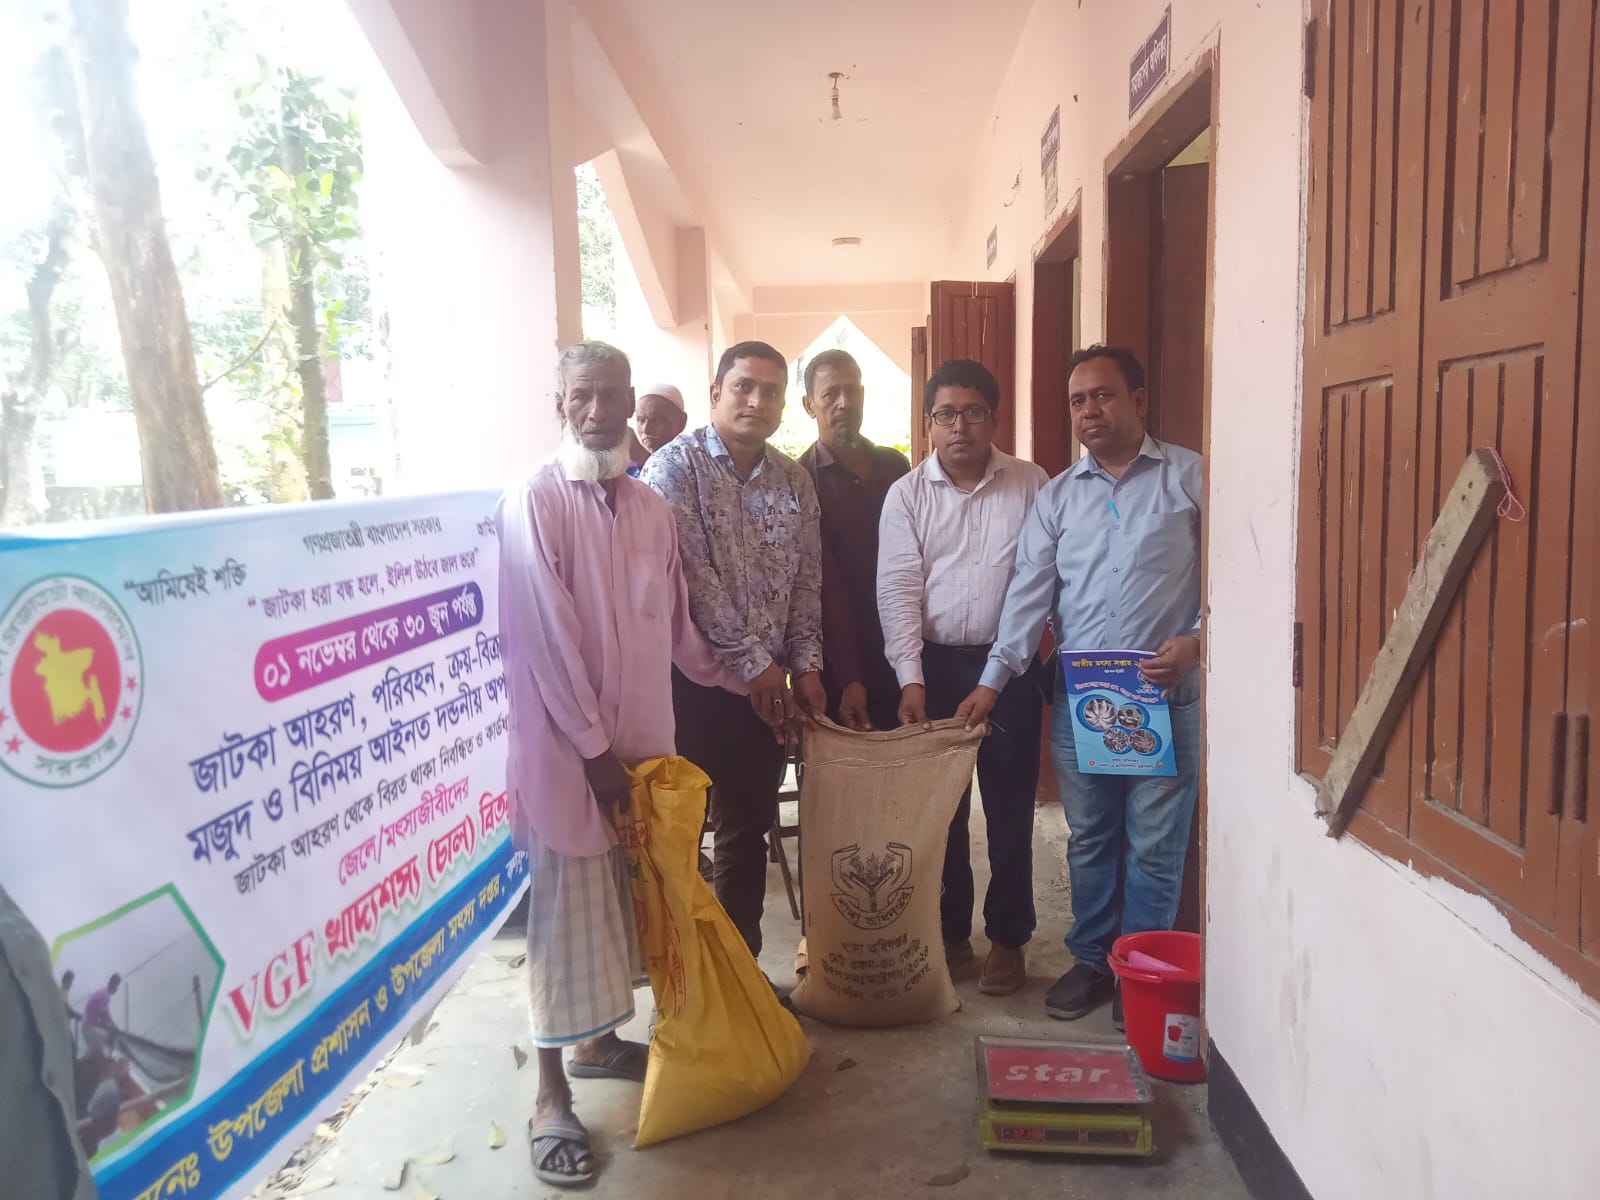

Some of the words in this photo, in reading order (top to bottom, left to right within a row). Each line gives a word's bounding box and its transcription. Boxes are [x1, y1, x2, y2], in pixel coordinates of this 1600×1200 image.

[212, 557, 248, 592] শক্তি
[366, 519, 411, 546] বাংলাদেশ
[411, 516, 442, 536] সরকার
[261, 587, 306, 620] জাটকা
[385, 561, 413, 588] ইলিশ
[414, 555, 439, 581] উঠবে
[263, 652, 291, 689] ০১
[296, 630, 357, 678] নভেম্বর
[361, 617, 399, 656] থেকে
[403, 616, 425, 641] ৩০
[427, 600, 449, 636] জুন
[451, 584, 478, 622] পর্যন্ত
[186, 799, 254, 864] মজুদ
[263, 788, 284, 822] ও
[289, 745, 364, 813] বিনিময়
[368, 711, 431, 765] আইনত
[188, 725, 277, 793] জাটকা
[233, 845, 287, 895] জাটকা
[290, 813, 340, 858] আহরণ
[344, 792, 375, 831] থেকে
[377, 772, 408, 809] বিরত
[410, 757, 437, 786] থাকা
[475, 731, 483, 748] ও
[339, 775, 470, 886] জেলে/মৎস্যজীবীদের
[227, 930, 316, 1032] VGF
[324, 854, 421, 956] খাদ্যশস্য
[427, 815, 476, 882] (চাল)
[207, 1058, 306, 1161] উপজেলা
[311, 998, 371, 1074] প্রশাসন
[375, 984, 389, 1012] ও
[391, 927, 446, 996] উপজেলা
[447, 898, 476, 942] মৎস্য
[1006, 1063, 1111, 1083] star
